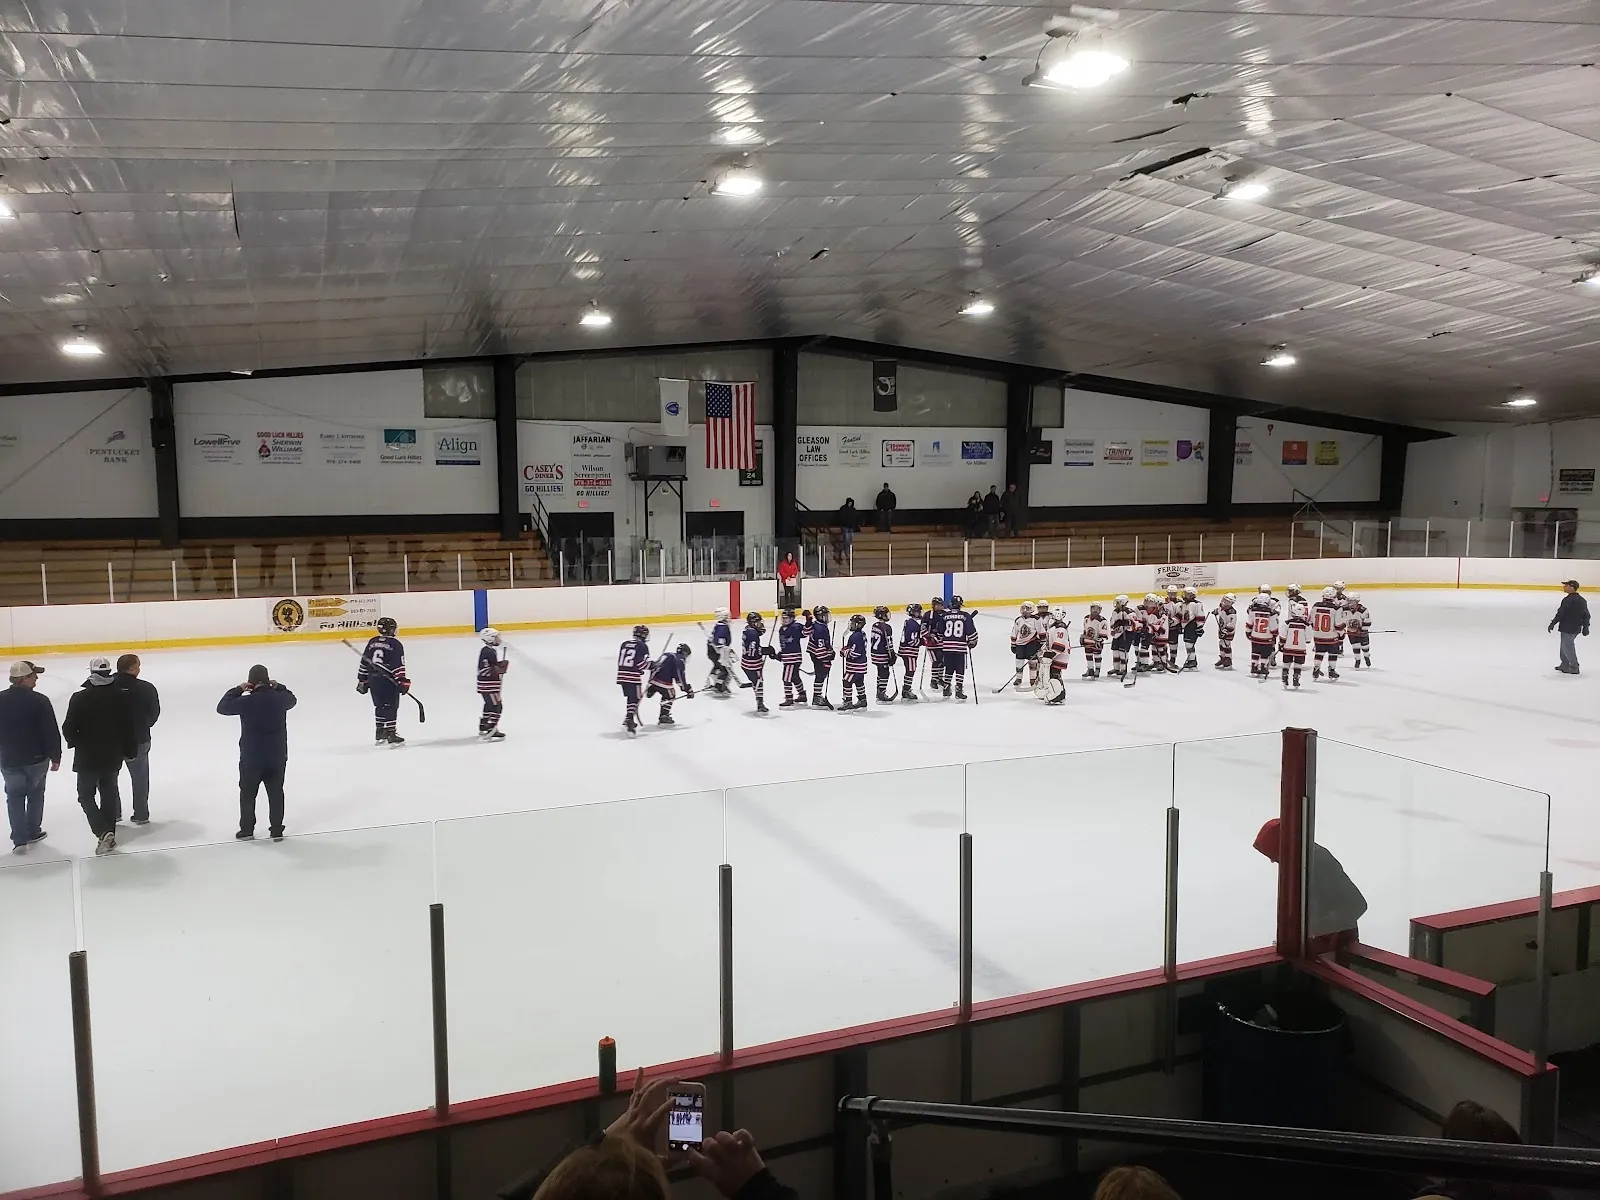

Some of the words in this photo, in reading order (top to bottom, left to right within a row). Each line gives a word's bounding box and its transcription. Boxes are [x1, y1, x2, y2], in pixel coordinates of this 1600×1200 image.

[193, 437, 241, 446] LowellFive
[437, 437, 478, 454] Align
[573, 436, 611, 444] JAFFARIAN
[797, 436, 830, 444] GLEASON
[271, 445, 303, 453] WILLIAMS
[806, 445, 821, 453] LAW
[799, 454, 828, 462] OFFICES
[523, 463, 564, 481] CASEY'S
[581, 464, 604, 472] Wilson
[574, 472, 611, 480] Screenprint
[944, 620, 964, 638] 88
[1254, 618, 1269, 634] 12
[1314, 613, 1331, 633] 10
[1293, 629, 1299, 646] 1
[372, 649, 384, 664] 6
[618, 648, 636, 668] 12
